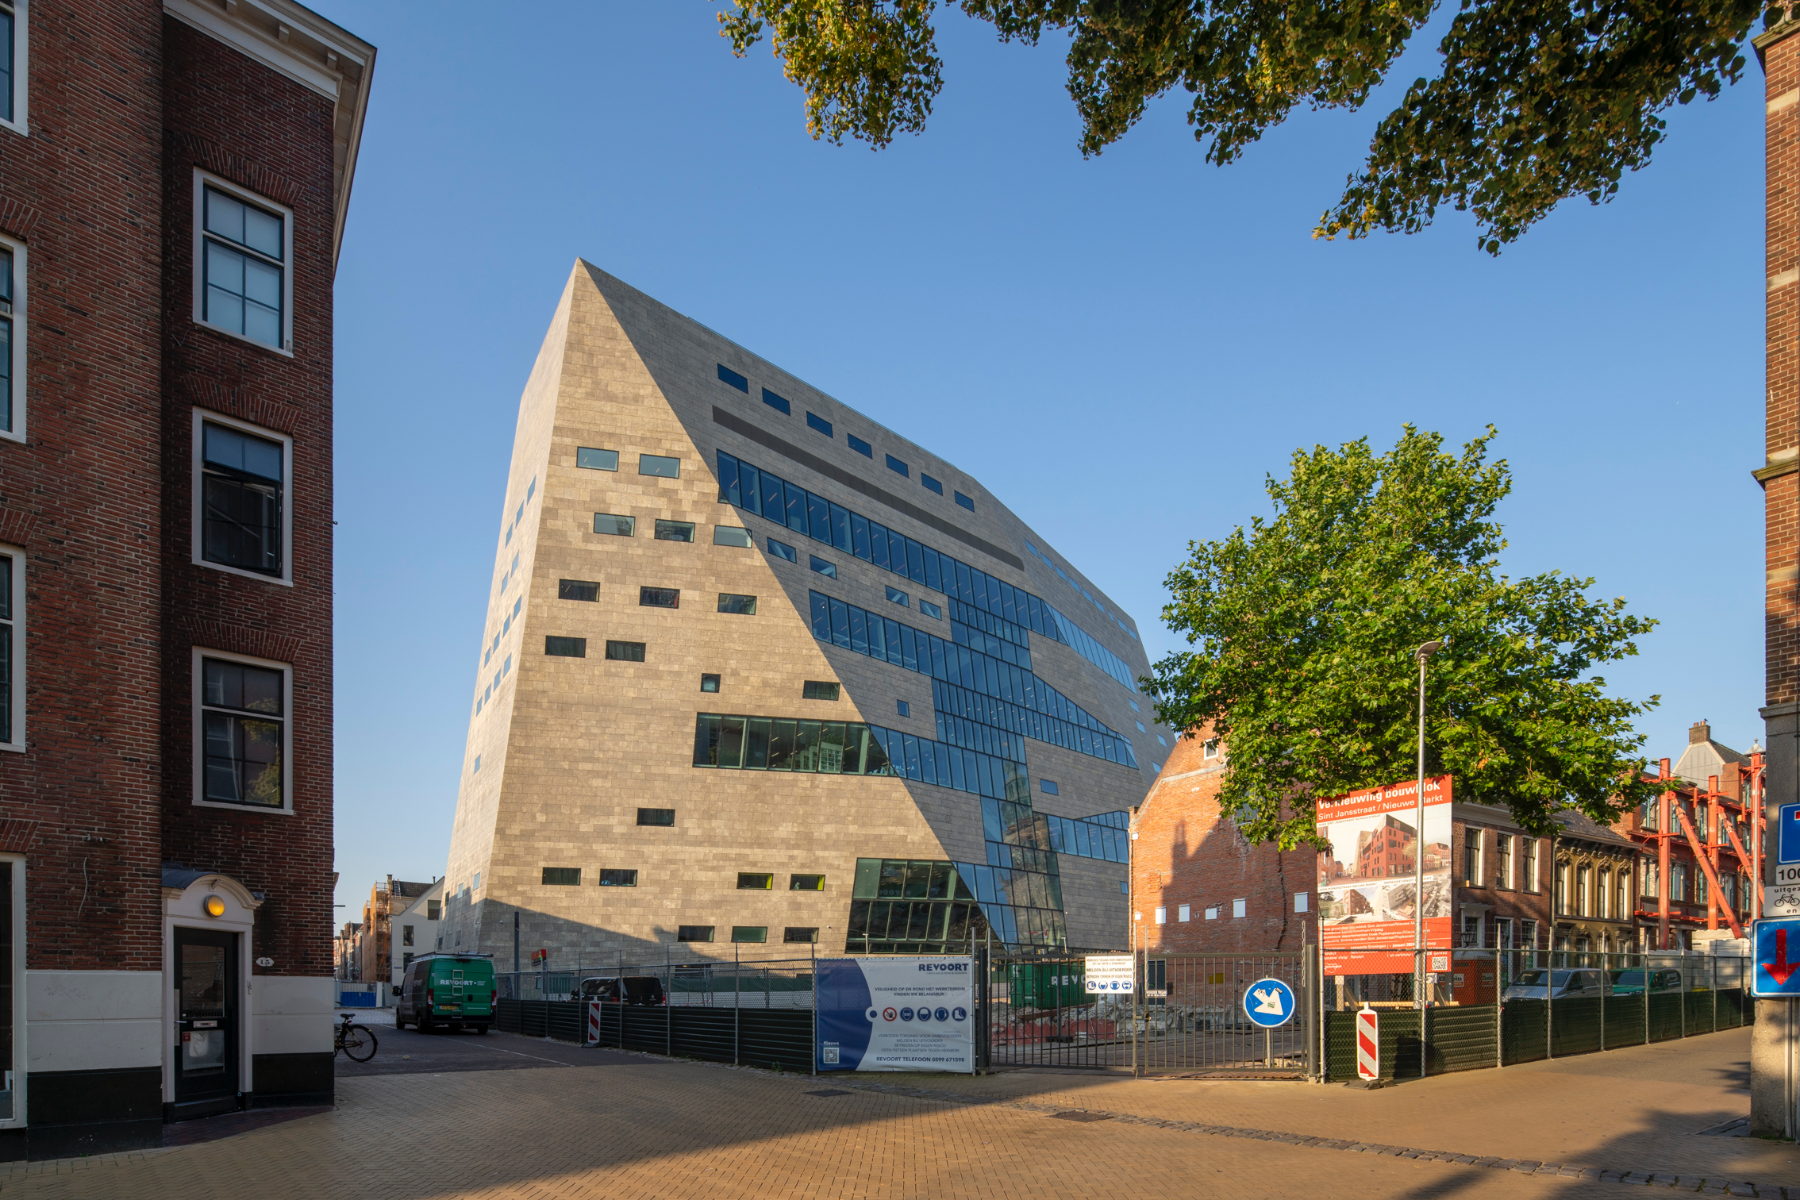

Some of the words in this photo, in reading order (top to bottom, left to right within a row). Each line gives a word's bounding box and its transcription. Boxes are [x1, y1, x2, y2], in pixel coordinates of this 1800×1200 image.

[1318, 792, 1382, 809] Vernieuwing
[1318, 812, 1333, 820] Sint
[1335, 805, 1376, 818] Jansstraat
[1382, 800, 1415, 810] Nieuwe
[919, 963, 969, 971] REVOORT
